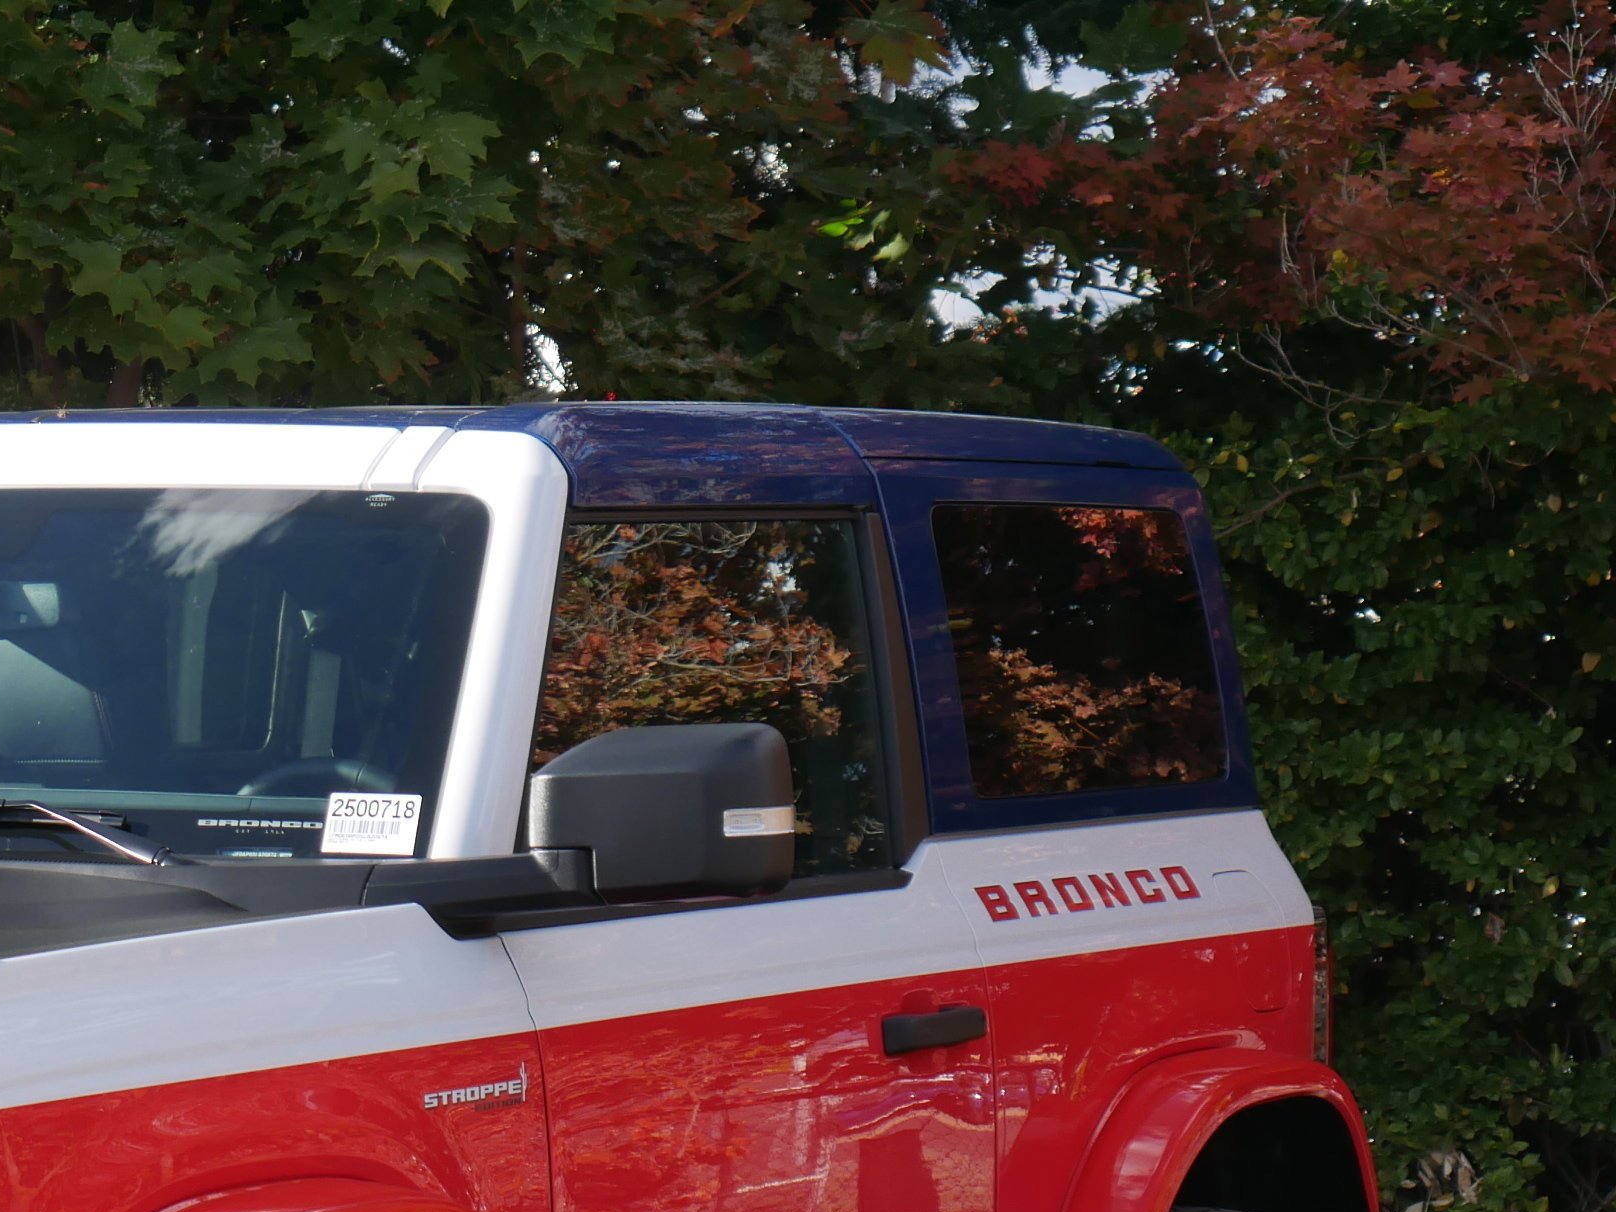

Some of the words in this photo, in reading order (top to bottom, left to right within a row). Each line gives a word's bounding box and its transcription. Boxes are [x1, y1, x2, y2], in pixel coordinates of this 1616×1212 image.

[331, 798, 416, 819] 2500718
[197, 819, 324, 828] BRONCO
[974, 865, 1201, 922] BRONCO
[424, 1079, 522, 1109] STROPPE
